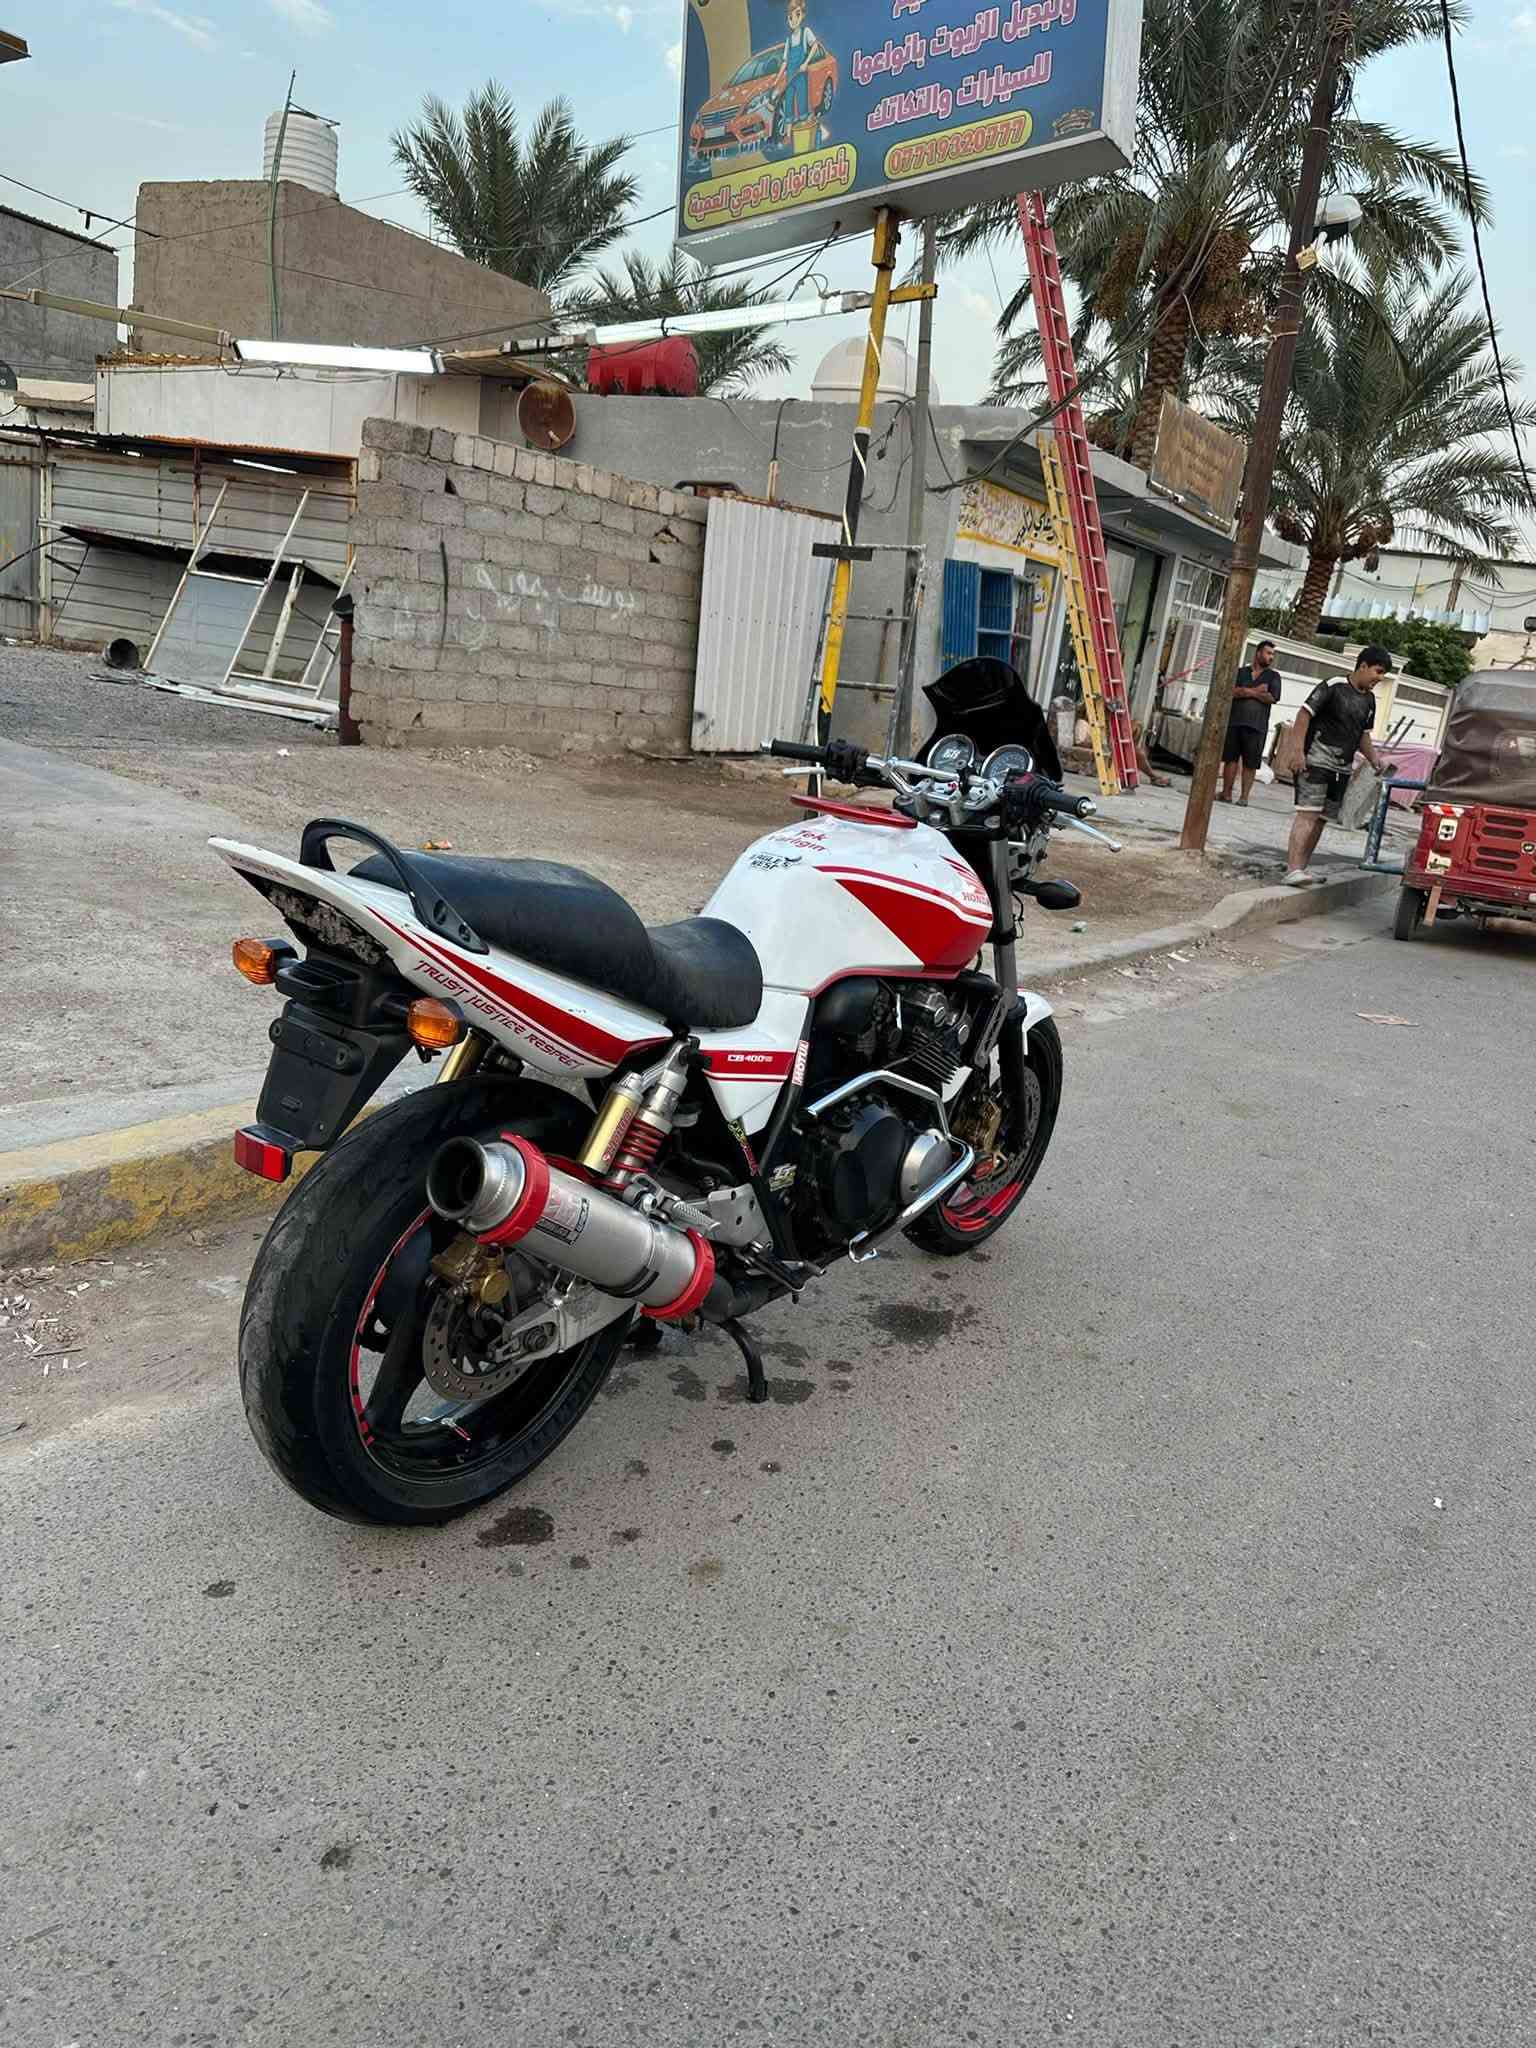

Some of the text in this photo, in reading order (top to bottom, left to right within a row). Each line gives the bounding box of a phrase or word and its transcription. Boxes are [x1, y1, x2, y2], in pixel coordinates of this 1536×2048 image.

[957, 50, 1052, 107] للسيارات
[414, 960, 585, 1069] TRUST JUSTICE RESPECT
